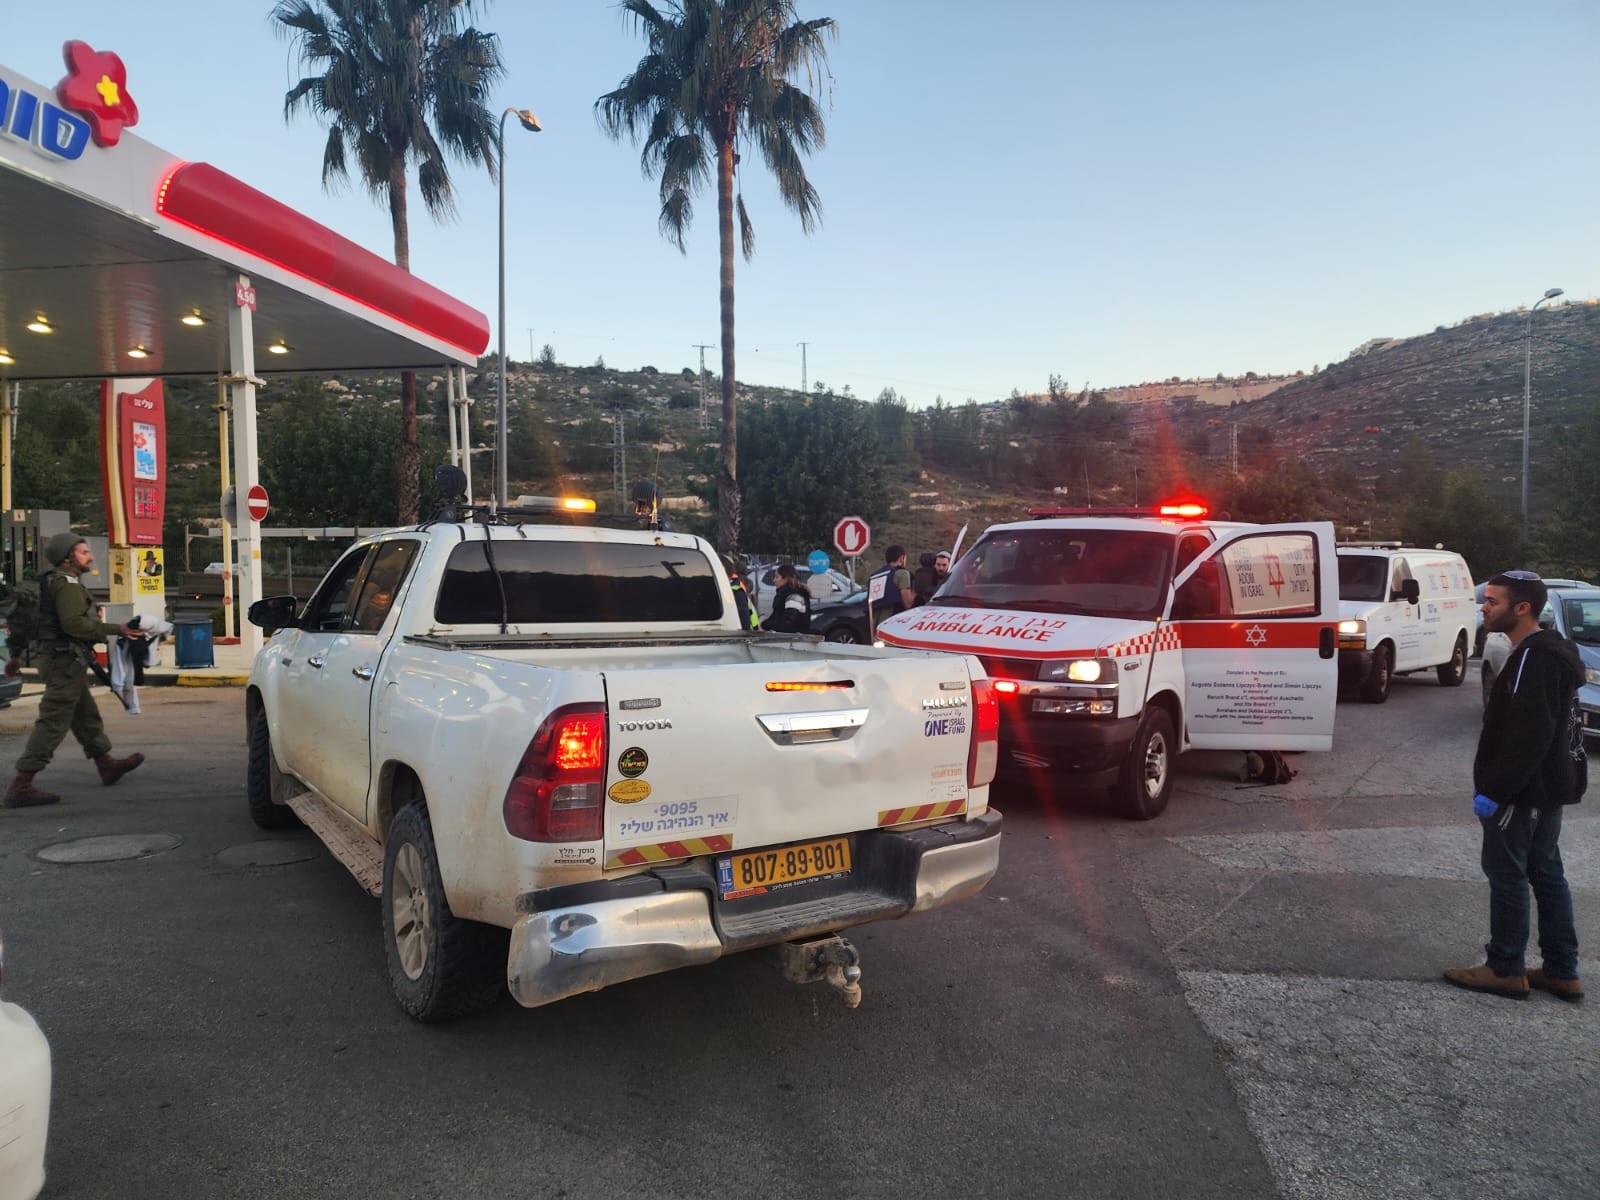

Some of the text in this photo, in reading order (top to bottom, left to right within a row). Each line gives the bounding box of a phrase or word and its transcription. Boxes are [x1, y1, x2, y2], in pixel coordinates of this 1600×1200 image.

[0, 78, 91, 160] סו
[982, 614, 1019, 623] דוד
[1025, 618, 1068, 629] מגן
[908, 621, 1055, 642] AMBULANCE
[617, 718, 673, 732] TOYOTA
[924, 719, 949, 738] ONE
[949, 718, 966, 727] ISRAEL
[949, 725, 966, 736] FUND
[657, 815, 703, 831] הנהיגה
[707, 812, 729, 827] איך
[722, 868, 732, 883] IL
